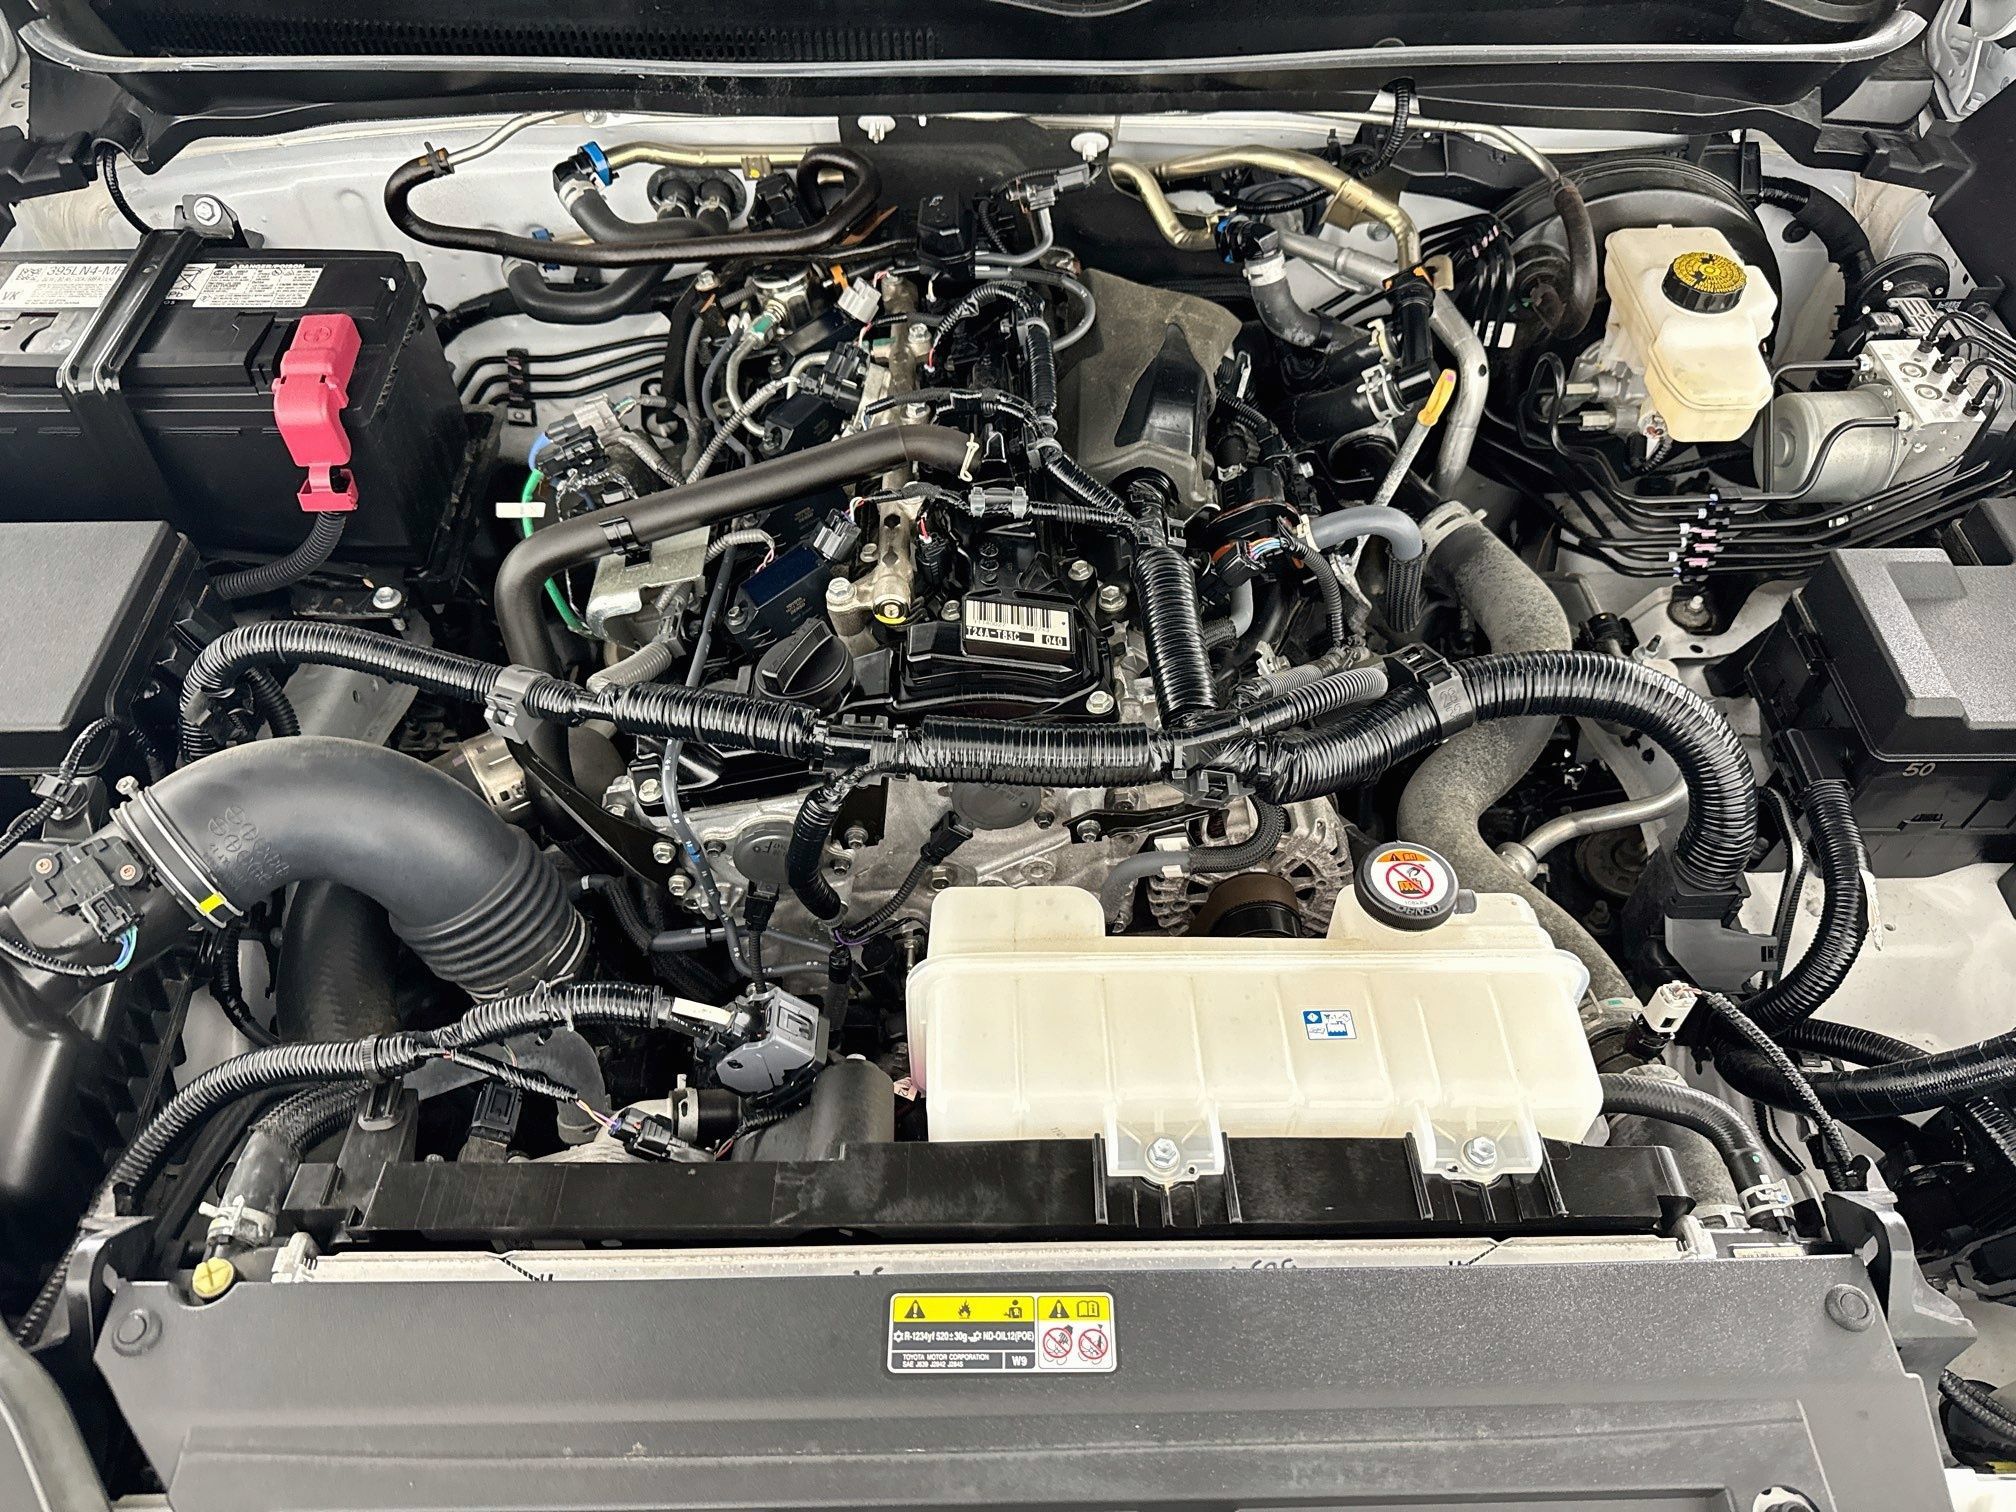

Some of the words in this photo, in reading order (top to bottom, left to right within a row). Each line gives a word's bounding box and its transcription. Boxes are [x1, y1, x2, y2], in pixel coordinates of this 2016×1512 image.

[966, 626, 1020, 641] T24A-T83C
[1045, 635, 1064, 646] 040
[1902, 762, 1936, 777] 50
[1396, 904, 1441, 915] DENSO
[904, 1331, 935, 1343] R-1234yf
[936, 1331, 968, 1343] 520±30g
[902, 1353, 925, 1361] TOYOTA
[926, 1353, 948, 1361] MOTOR
[948, 1353, 990, 1361] CORPORATION
[1012, 1356, 1028, 1367] W9
